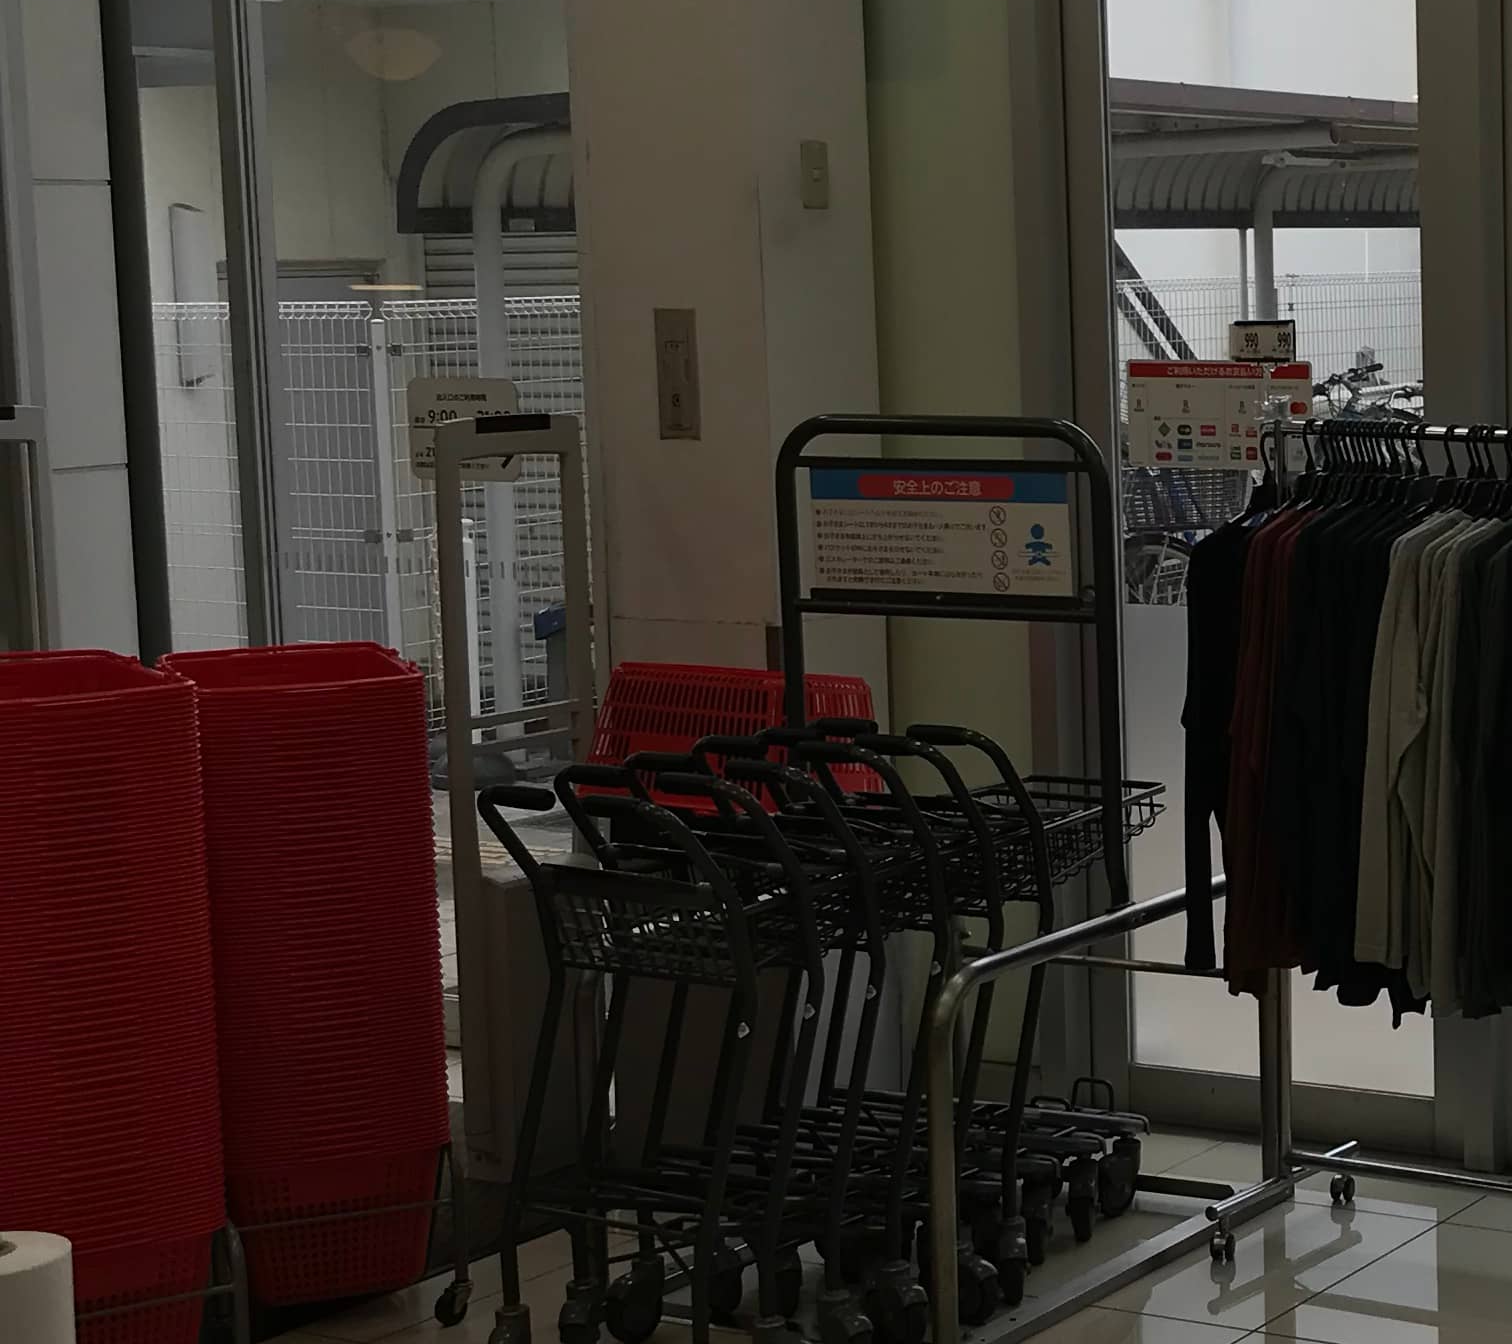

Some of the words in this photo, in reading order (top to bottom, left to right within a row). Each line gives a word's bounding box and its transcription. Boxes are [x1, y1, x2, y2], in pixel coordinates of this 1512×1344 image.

[892, 479, 982, 496] 安全上のご注意
